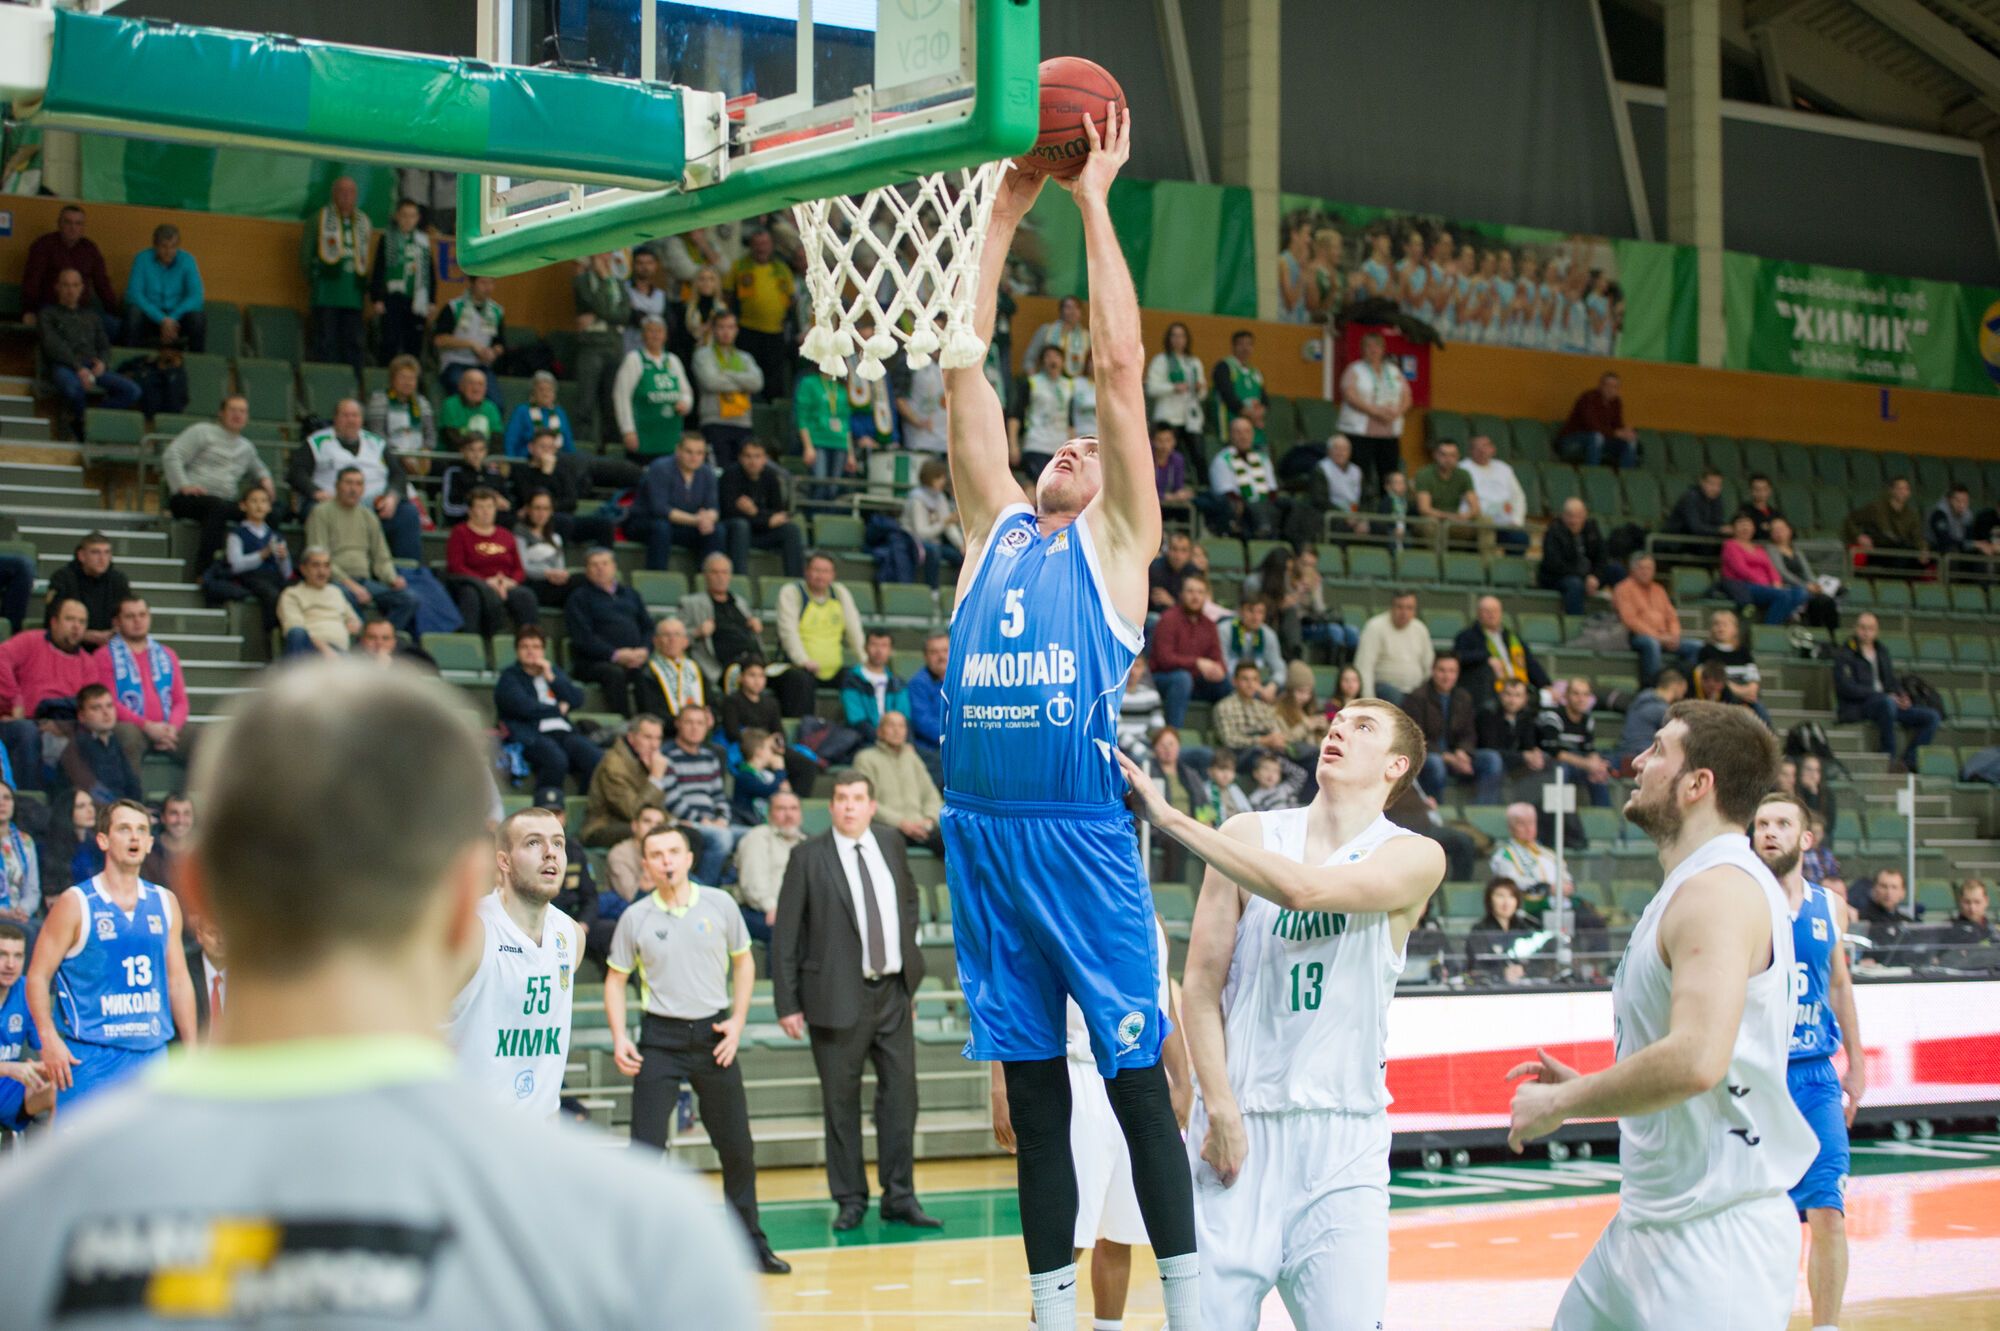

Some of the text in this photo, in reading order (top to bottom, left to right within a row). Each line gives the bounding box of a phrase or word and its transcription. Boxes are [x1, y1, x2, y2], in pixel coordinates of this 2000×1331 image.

[1000, 588, 1025, 638] 5
[961, 643, 1077, 688] МИКОЛАЇВ
[963, 704, 1040, 720] ТЕХНОТОРГ
[121, 954, 153, 987] 13
[1290, 961, 1323, 1011] 13
[523, 975, 551, 1015] 55
[495, 1026, 561, 1057] ХІМК
